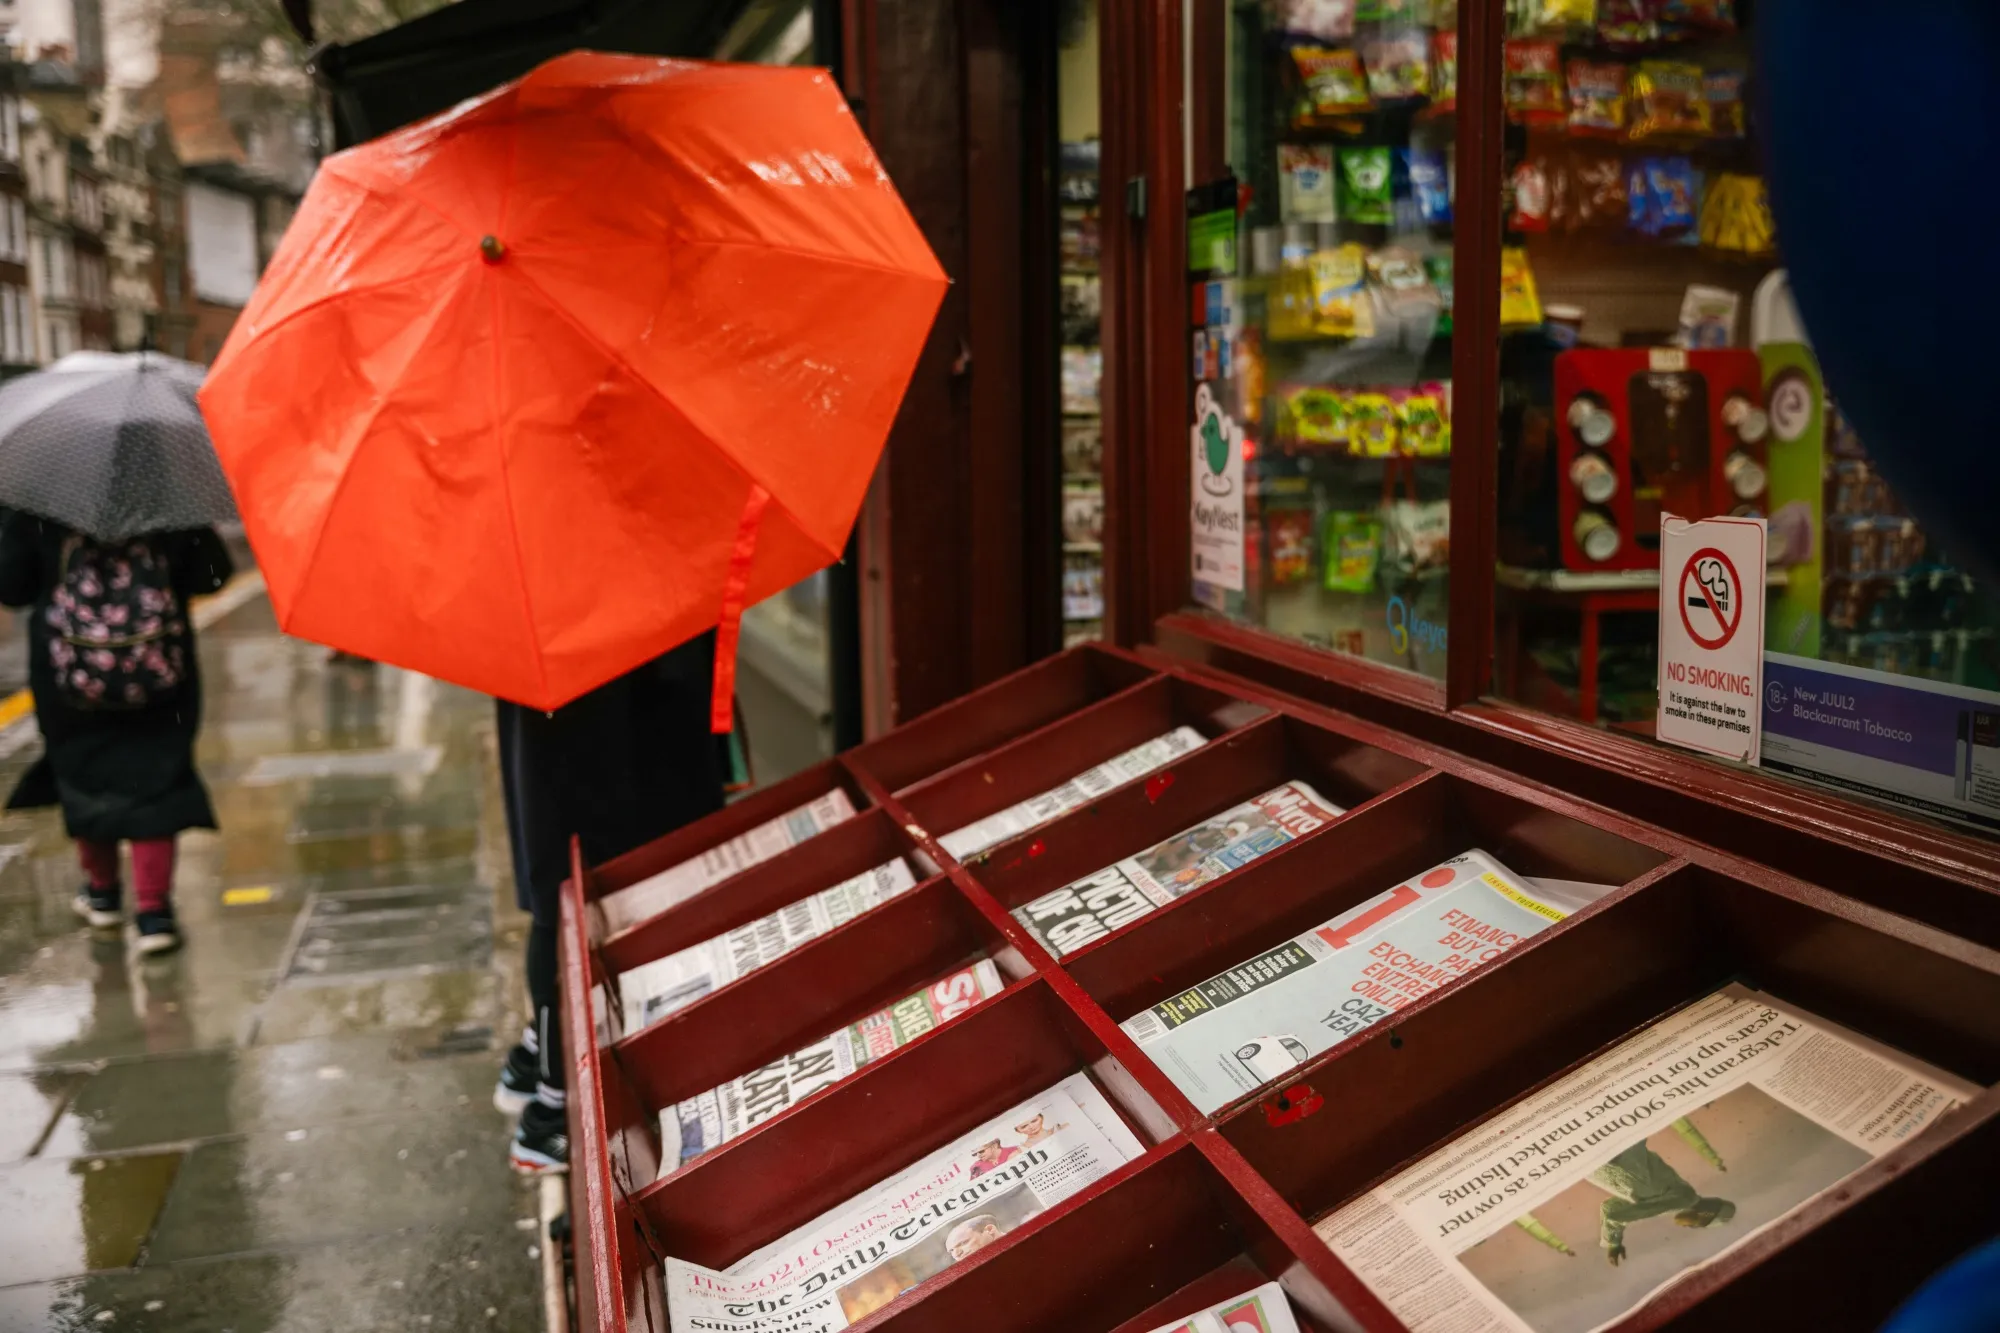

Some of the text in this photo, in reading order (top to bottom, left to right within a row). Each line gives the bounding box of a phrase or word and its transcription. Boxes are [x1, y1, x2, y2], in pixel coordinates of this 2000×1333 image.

[1667, 662, 1686, 682] NO
[1670, 691, 1746, 718] It is against the law to
[1770, 688, 1788, 705] 18+
[1793, 687, 1855, 711] New JUUL2
[1665, 707, 1751, 734] smoke in these premises
[1793, 704, 1912, 743] Blackcurrant Tobacco
[1436, 928, 1484, 958] BUY
[1718, 1008, 1784, 1045] gears
[1660, 1055, 1703, 1080] for
[1689, 1038, 1728, 1060] up
[1698, 1018, 1807, 1082] Telegram
[1575, 1070, 1671, 1126] bumper
[1659, 1074, 1711, 1104] hits
[1580, 1096, 1669, 1149] 900mn
[1851, 1081, 1929, 1137] Muslim anger
[1864, 1085, 1939, 1143] India law stirs
[1501, 1118, 1590, 1170] market
[1525, 1143, 1589, 1181] users
[1434, 1161, 1514, 1209] listing
[1499, 1176, 1532, 1196] as
[687, 1163, 961, 1293] The 2024 Oscars special
[724, 1147, 1049, 1316] The Daily Telegraph
[1431, 1191, 1508, 1238] owner
[690, 1316, 784, 1332] Sunak's
[787, 1296, 833, 1321] new
